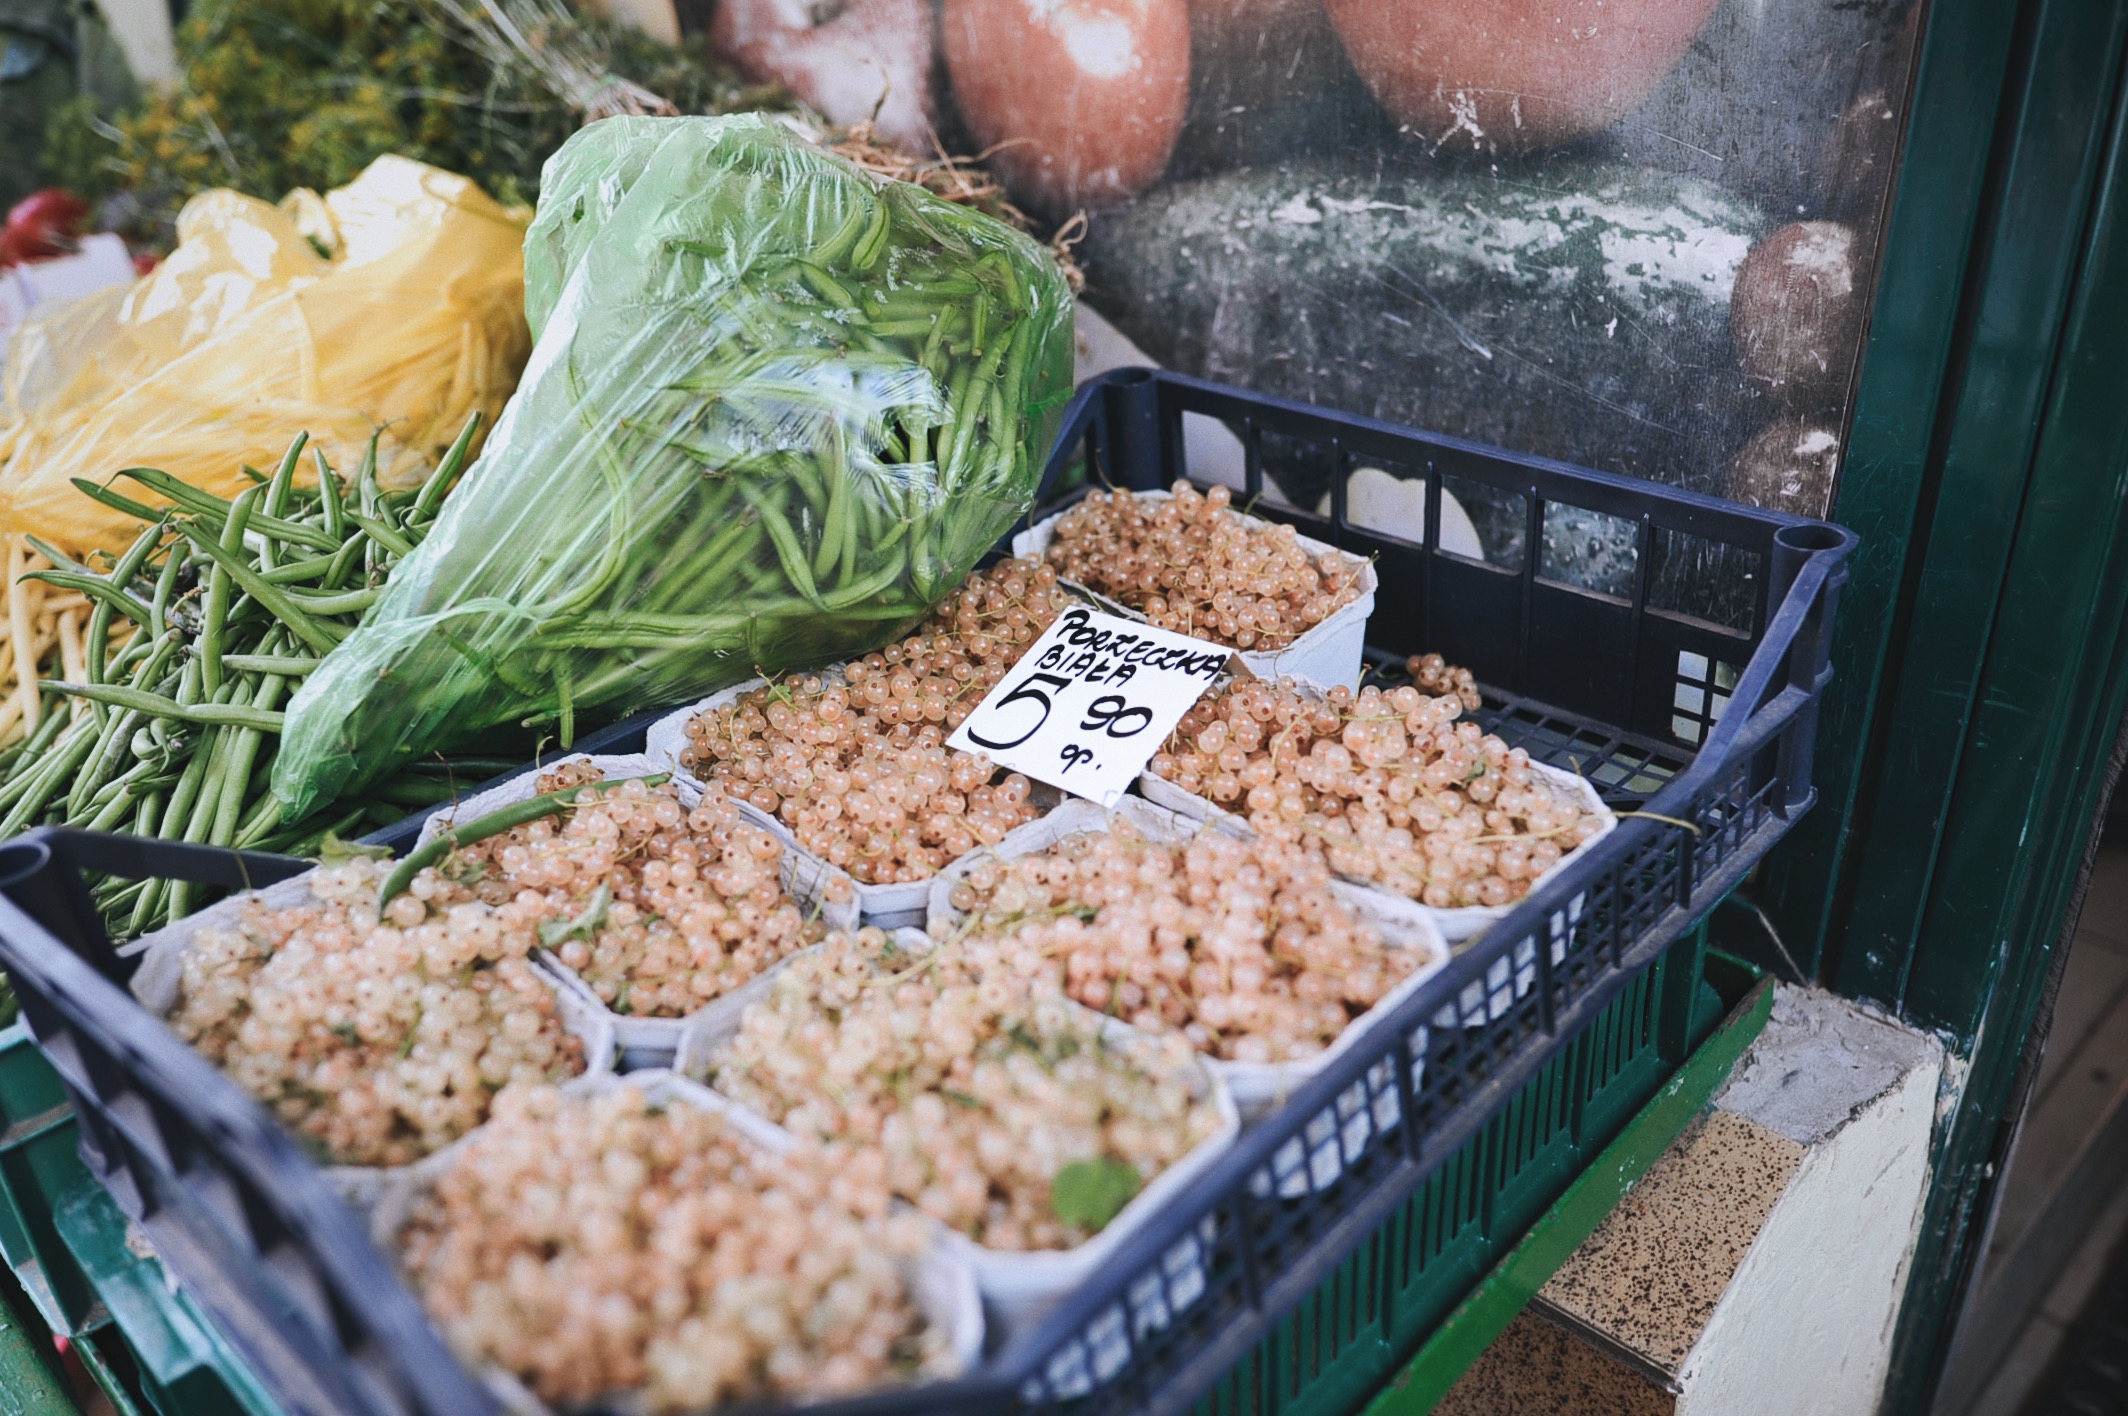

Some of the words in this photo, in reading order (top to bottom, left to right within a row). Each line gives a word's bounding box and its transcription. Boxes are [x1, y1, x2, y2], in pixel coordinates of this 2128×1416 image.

[1034, 644, 1137, 688] BIAŁA
[1056, 609, 1227, 681] PORZECZKA
[967, 672, 1073, 751] 5
[1080, 695, 1153, 738] 90
